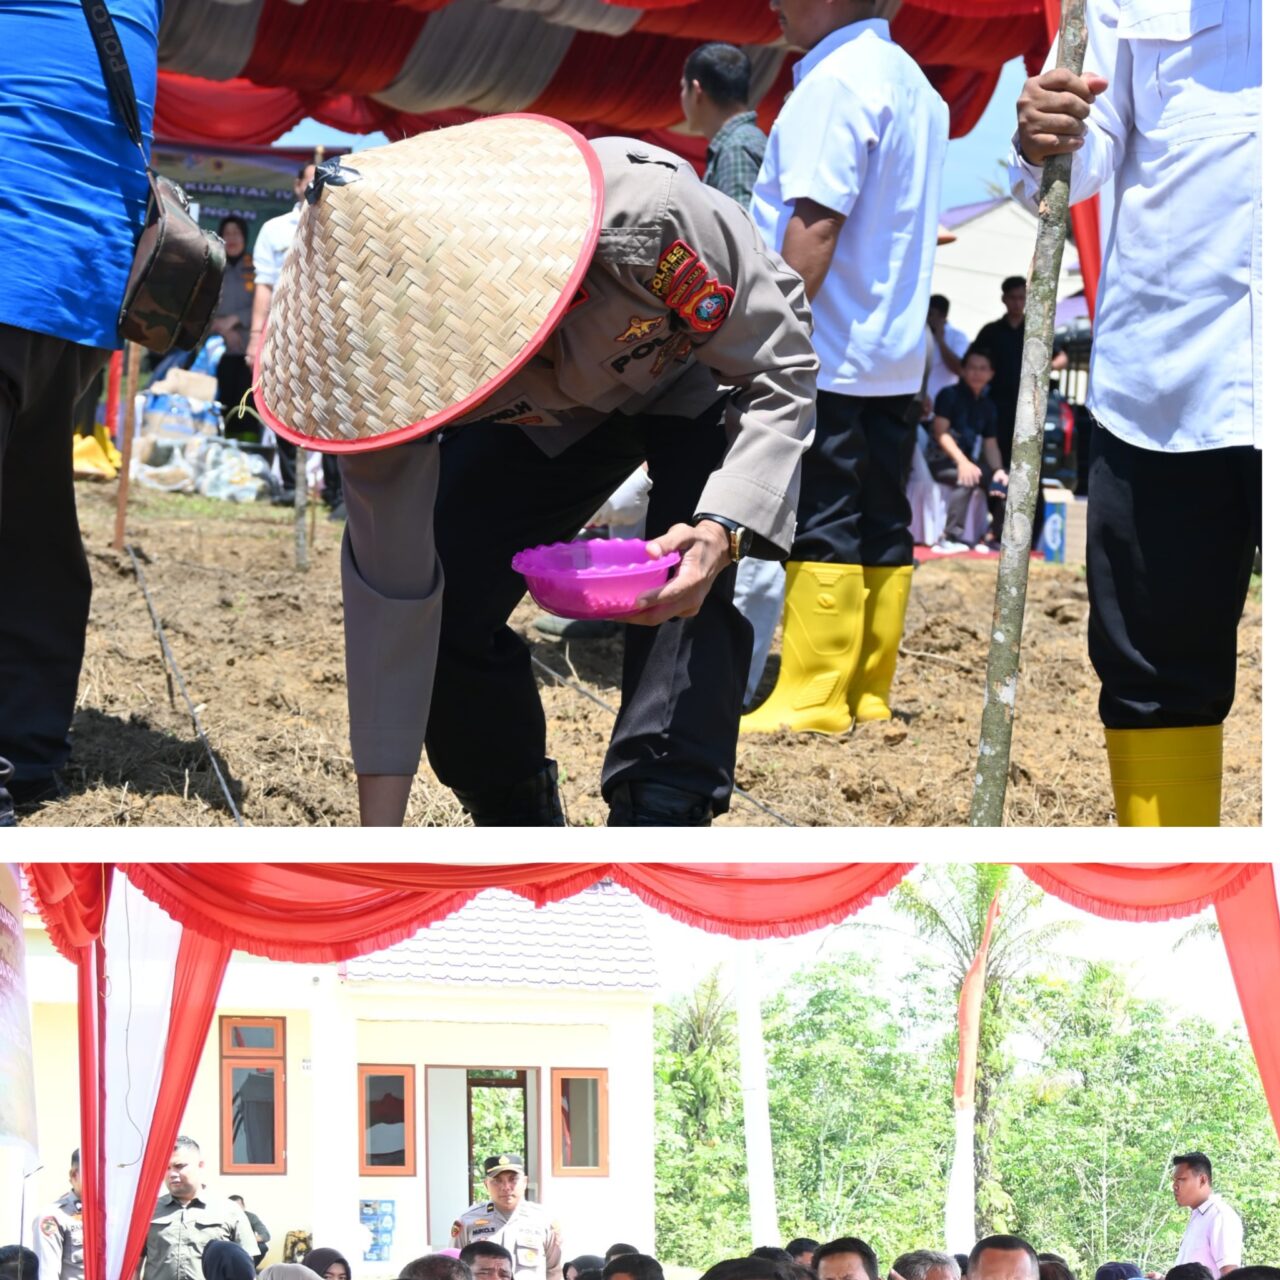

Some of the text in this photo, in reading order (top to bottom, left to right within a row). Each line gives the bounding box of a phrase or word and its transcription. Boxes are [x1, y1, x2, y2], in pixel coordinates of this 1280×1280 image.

[91, 4, 129, 73] POLO
[184, 182, 269, 198] KUARTAL
[611, 336, 669, 374] POL
